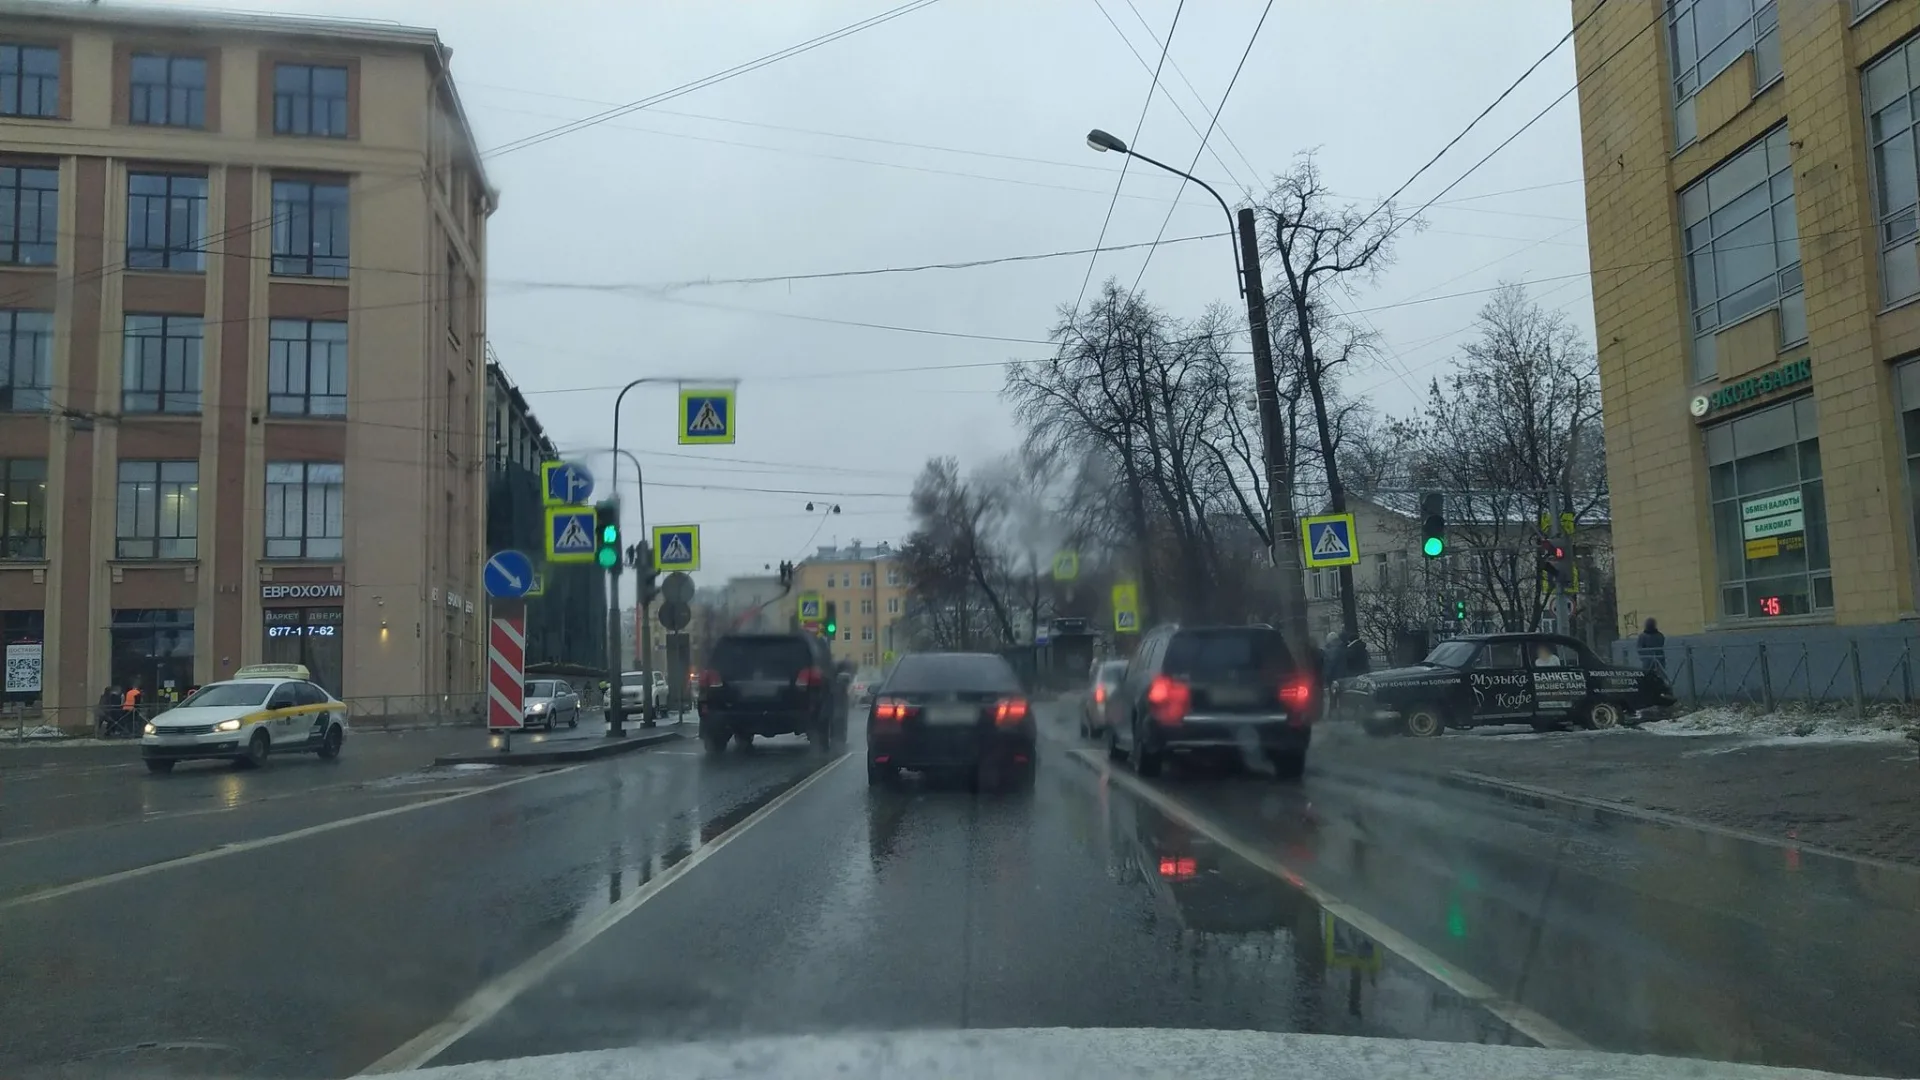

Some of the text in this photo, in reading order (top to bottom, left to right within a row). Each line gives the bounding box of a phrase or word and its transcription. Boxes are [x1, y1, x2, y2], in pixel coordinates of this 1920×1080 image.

[1710, 357, 1811, 411] ЭКСИ-БАНК
[1745, 496, 1800, 514] ОБМЕН ВАЛЮТЫ
[1755, 519, 1792, 533] БАНКОМАТ
[262, 585, 342, 598] ЕВРОХОУМ
[309, 612, 342, 620] ДВЕРИ
[1470, 673, 1528, 689] Музыка
[1533, 671, 1585, 681] БАНКЕТЫ
[1535, 681, 1586, 690] БИЗНЕС ЛАНЧ
[1495, 689, 1532, 709] Кофе
